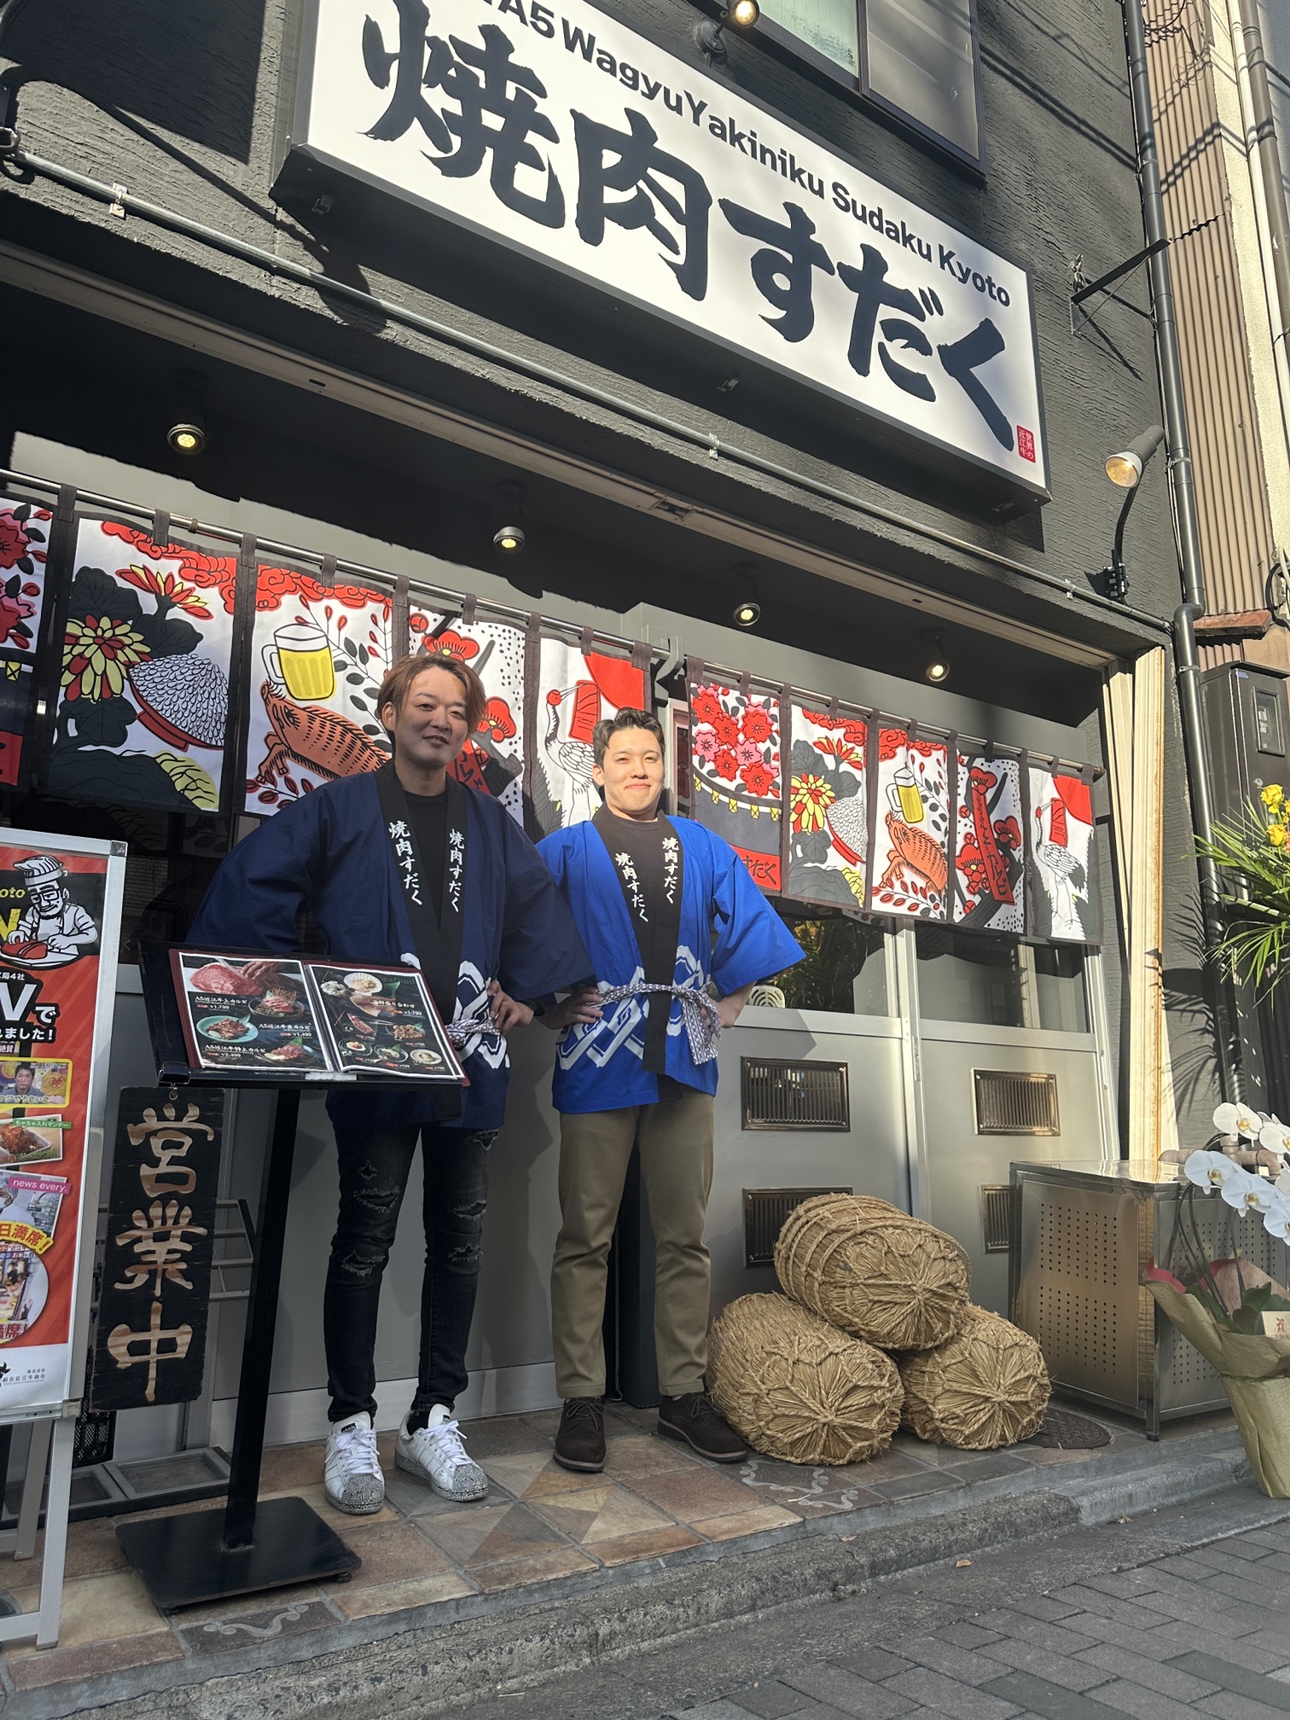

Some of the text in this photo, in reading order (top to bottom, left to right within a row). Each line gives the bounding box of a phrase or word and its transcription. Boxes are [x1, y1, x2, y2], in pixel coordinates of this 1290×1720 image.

[355, 0, 1015, 451] 焼肉すだく
[832, 181, 931, 263] Sudaku
[938, 244, 1010, 308] Kyoto
[388, 820, 423, 906] 焼肉すだく
[449, 828, 465, 912] 焼肉すだく
[614, 852, 649, 922] 焼肉すだく
[662, 836, 680, 904] 焼肉すだく
[12, 1179, 38, 1189] news
[39, 1182, 68, 1193] every.
[107, 1102, 215, 1402] 営業中
